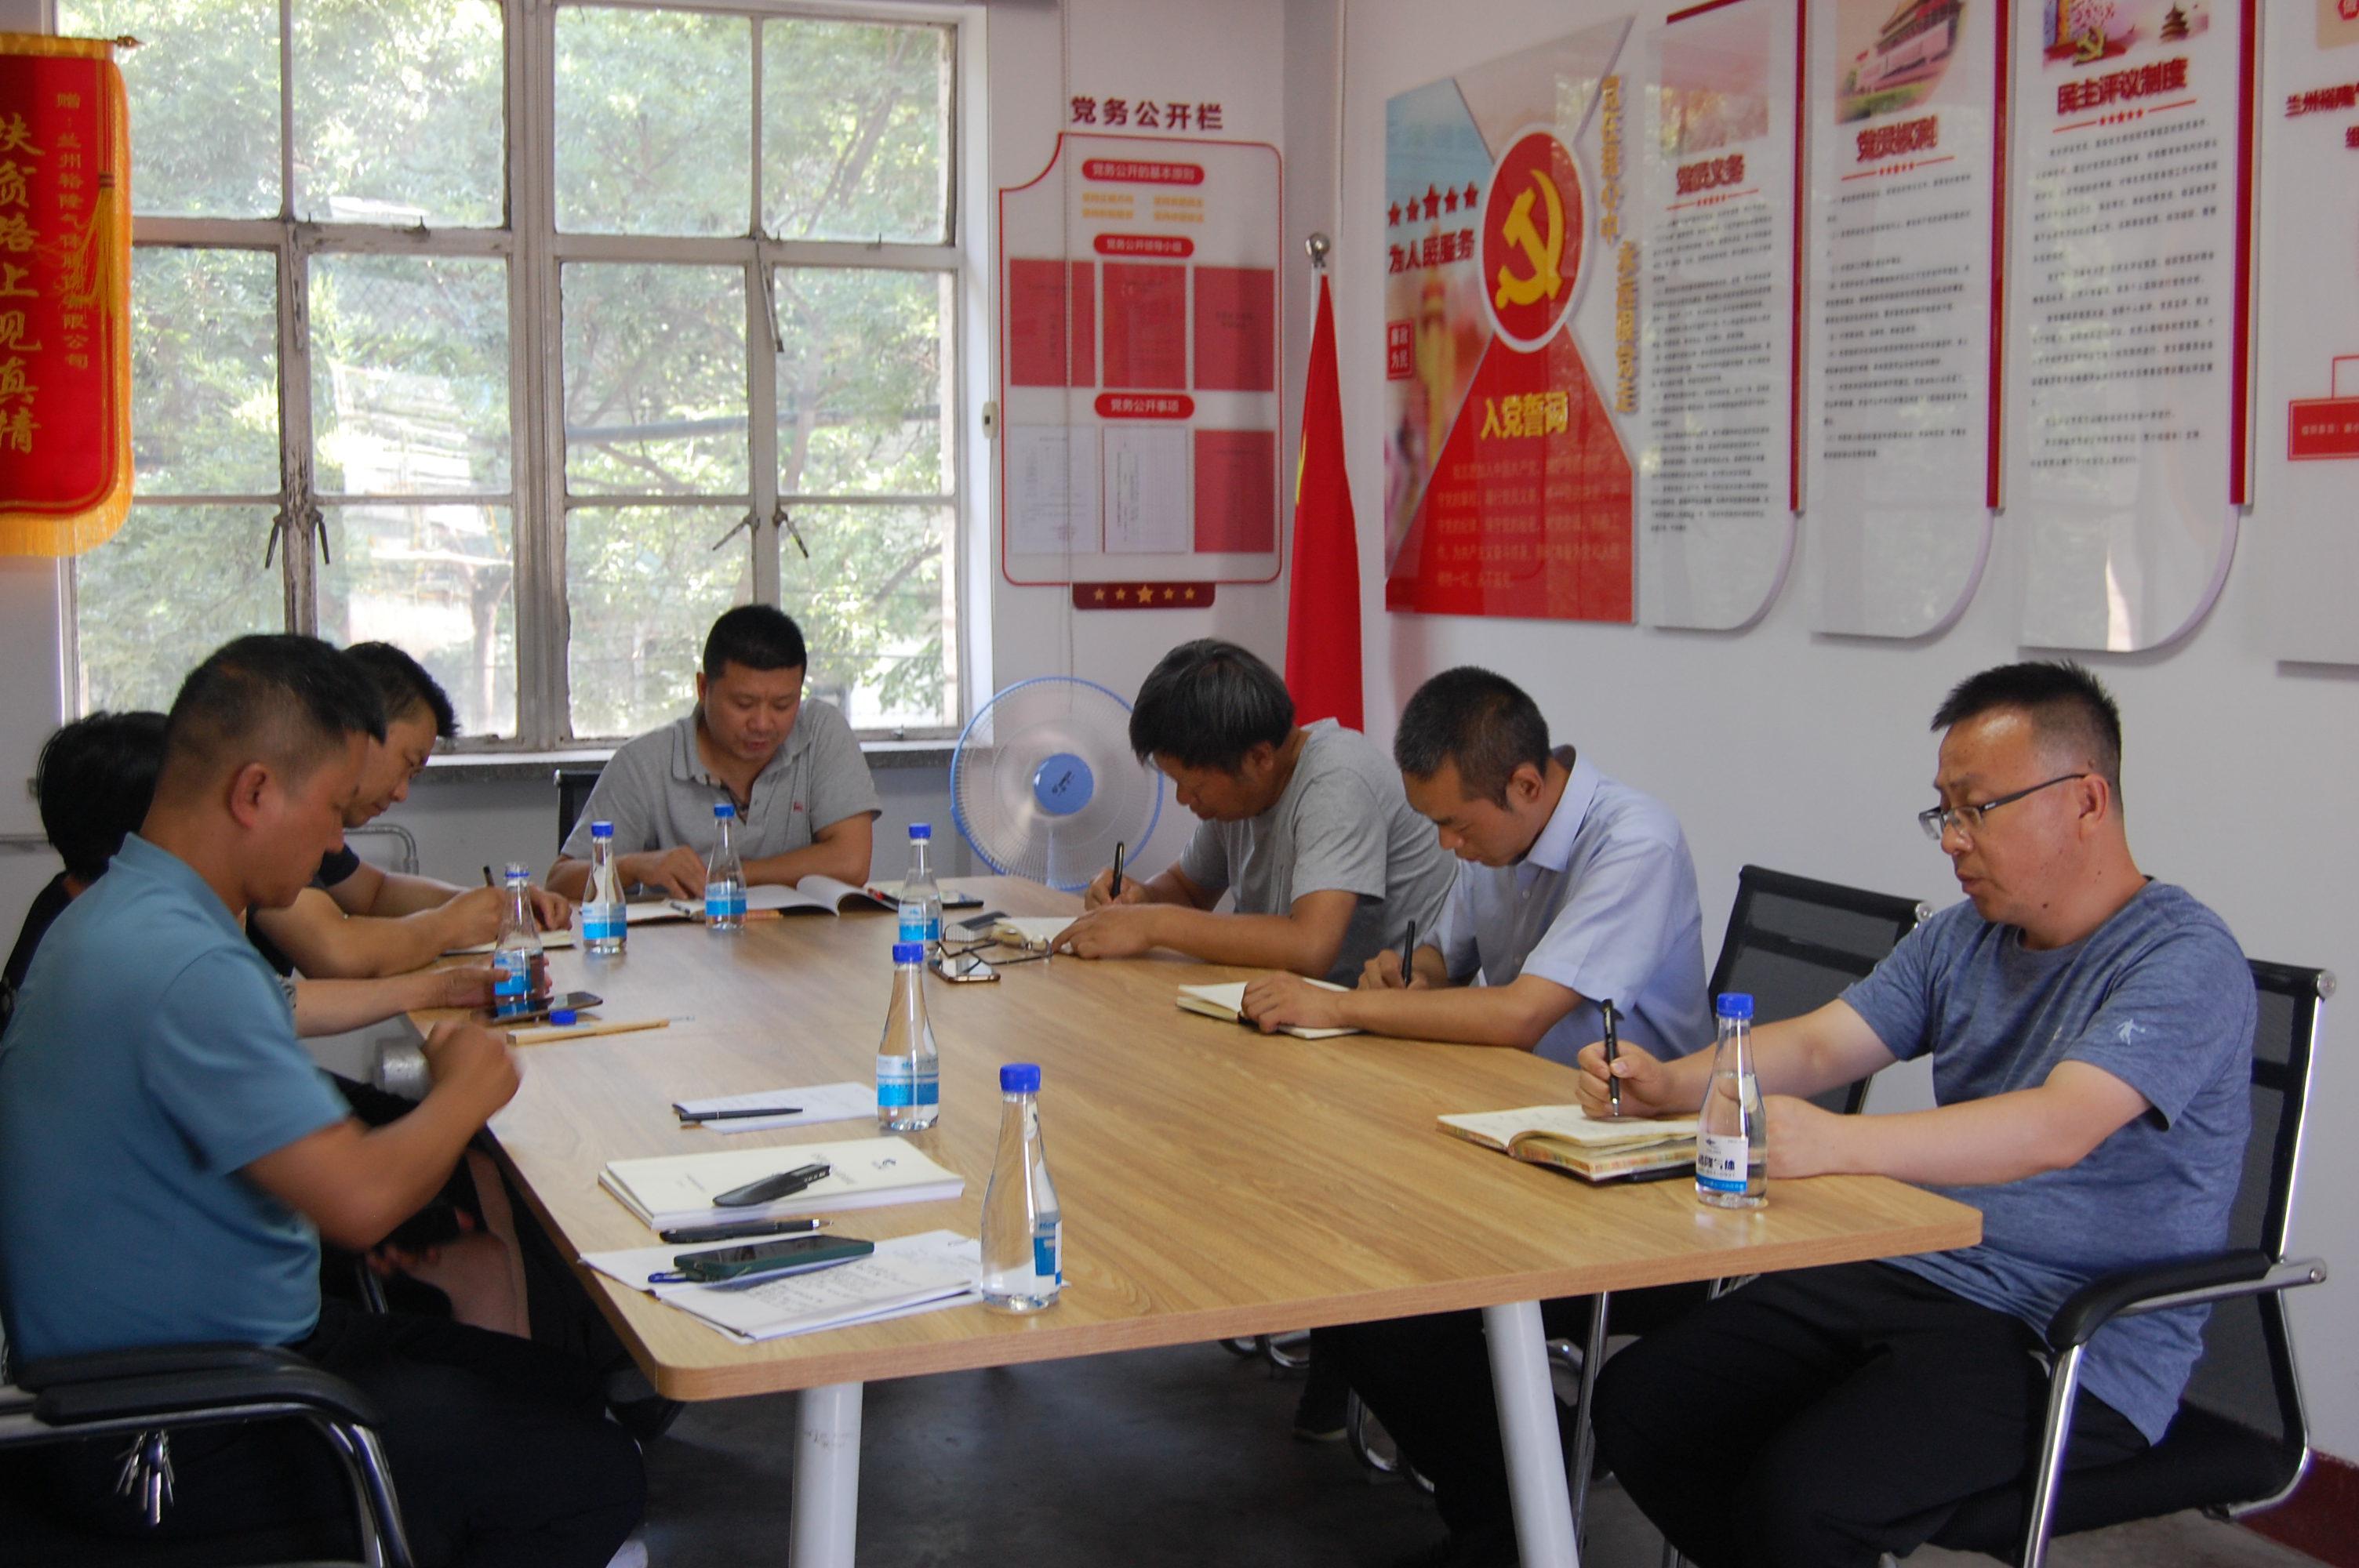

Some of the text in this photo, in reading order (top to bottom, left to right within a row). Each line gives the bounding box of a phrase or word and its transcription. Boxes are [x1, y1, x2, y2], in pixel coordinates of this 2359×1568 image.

[2057, 57, 2189, 115] 民主评议制度
[2284, 82, 2359, 118] 兰州裕隆
[1071, 96, 1223, 130] 党务公开栏
[1388, 227, 1474, 274] 为人民服务
[0, 112, 45, 454] 扶贫路上见真情
[1480, 390, 1569, 441] 入党誓词
